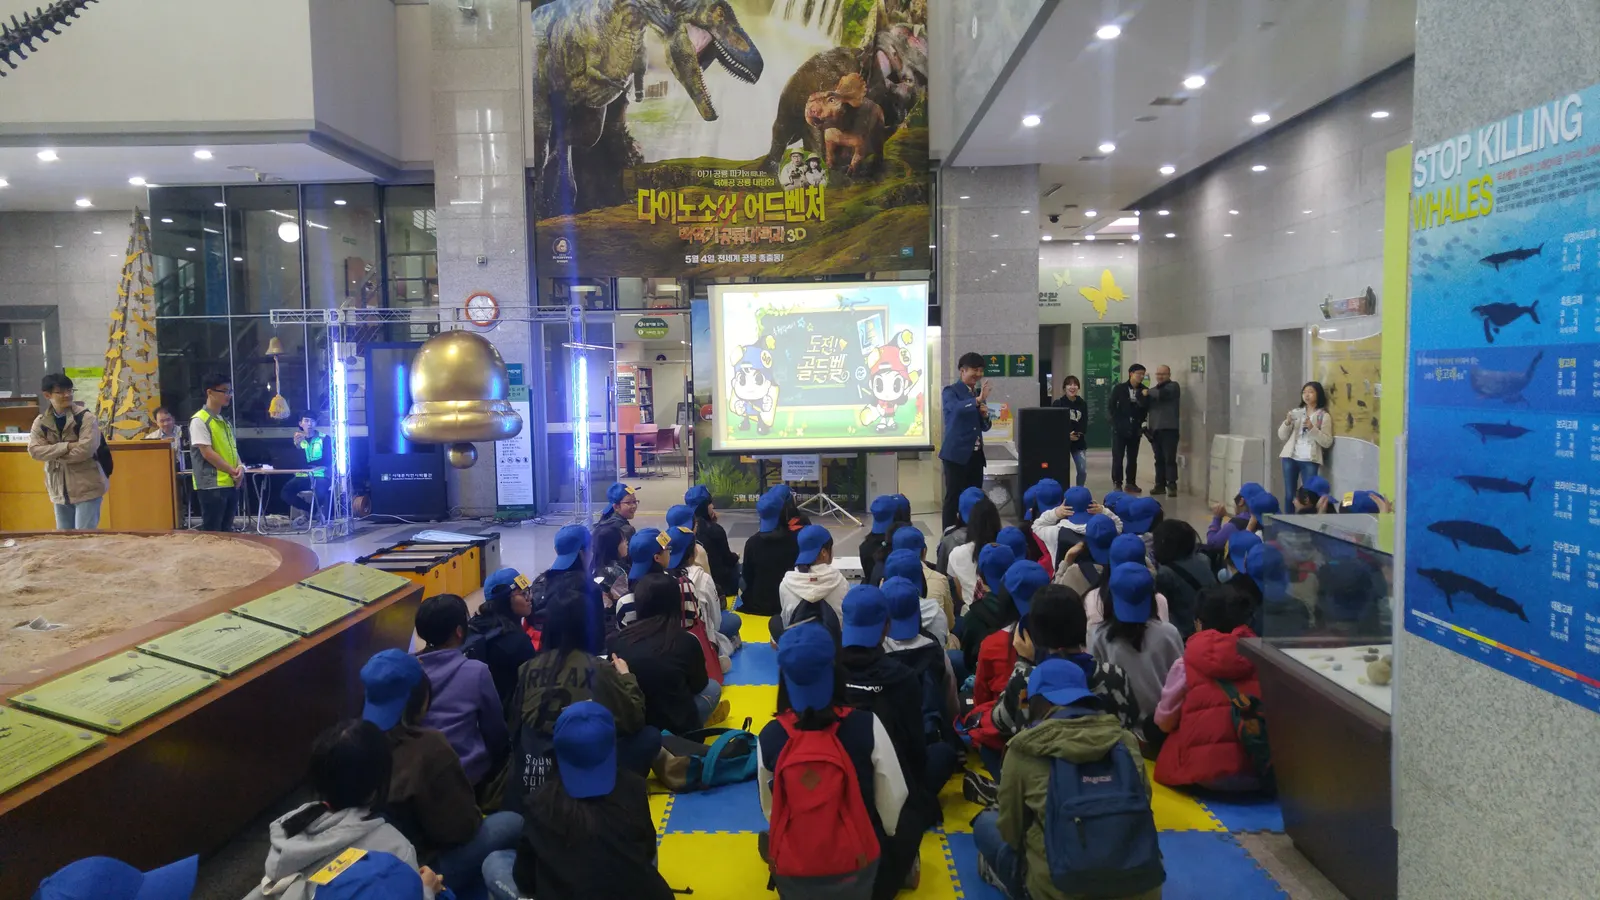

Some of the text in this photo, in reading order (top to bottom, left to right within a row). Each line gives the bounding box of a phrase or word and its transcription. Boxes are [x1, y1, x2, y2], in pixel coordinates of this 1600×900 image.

[1414, 94, 1583, 188] STOP KILLING
[744, 184, 826, 224] 어드벤처
[1413, 174, 1494, 231] WHALES
[786, 227, 807, 243] 3D
[685, 255, 699, 264] 5월
[806, 334, 838, 356] 도전!
[796, 353, 850, 384] 골든벨
